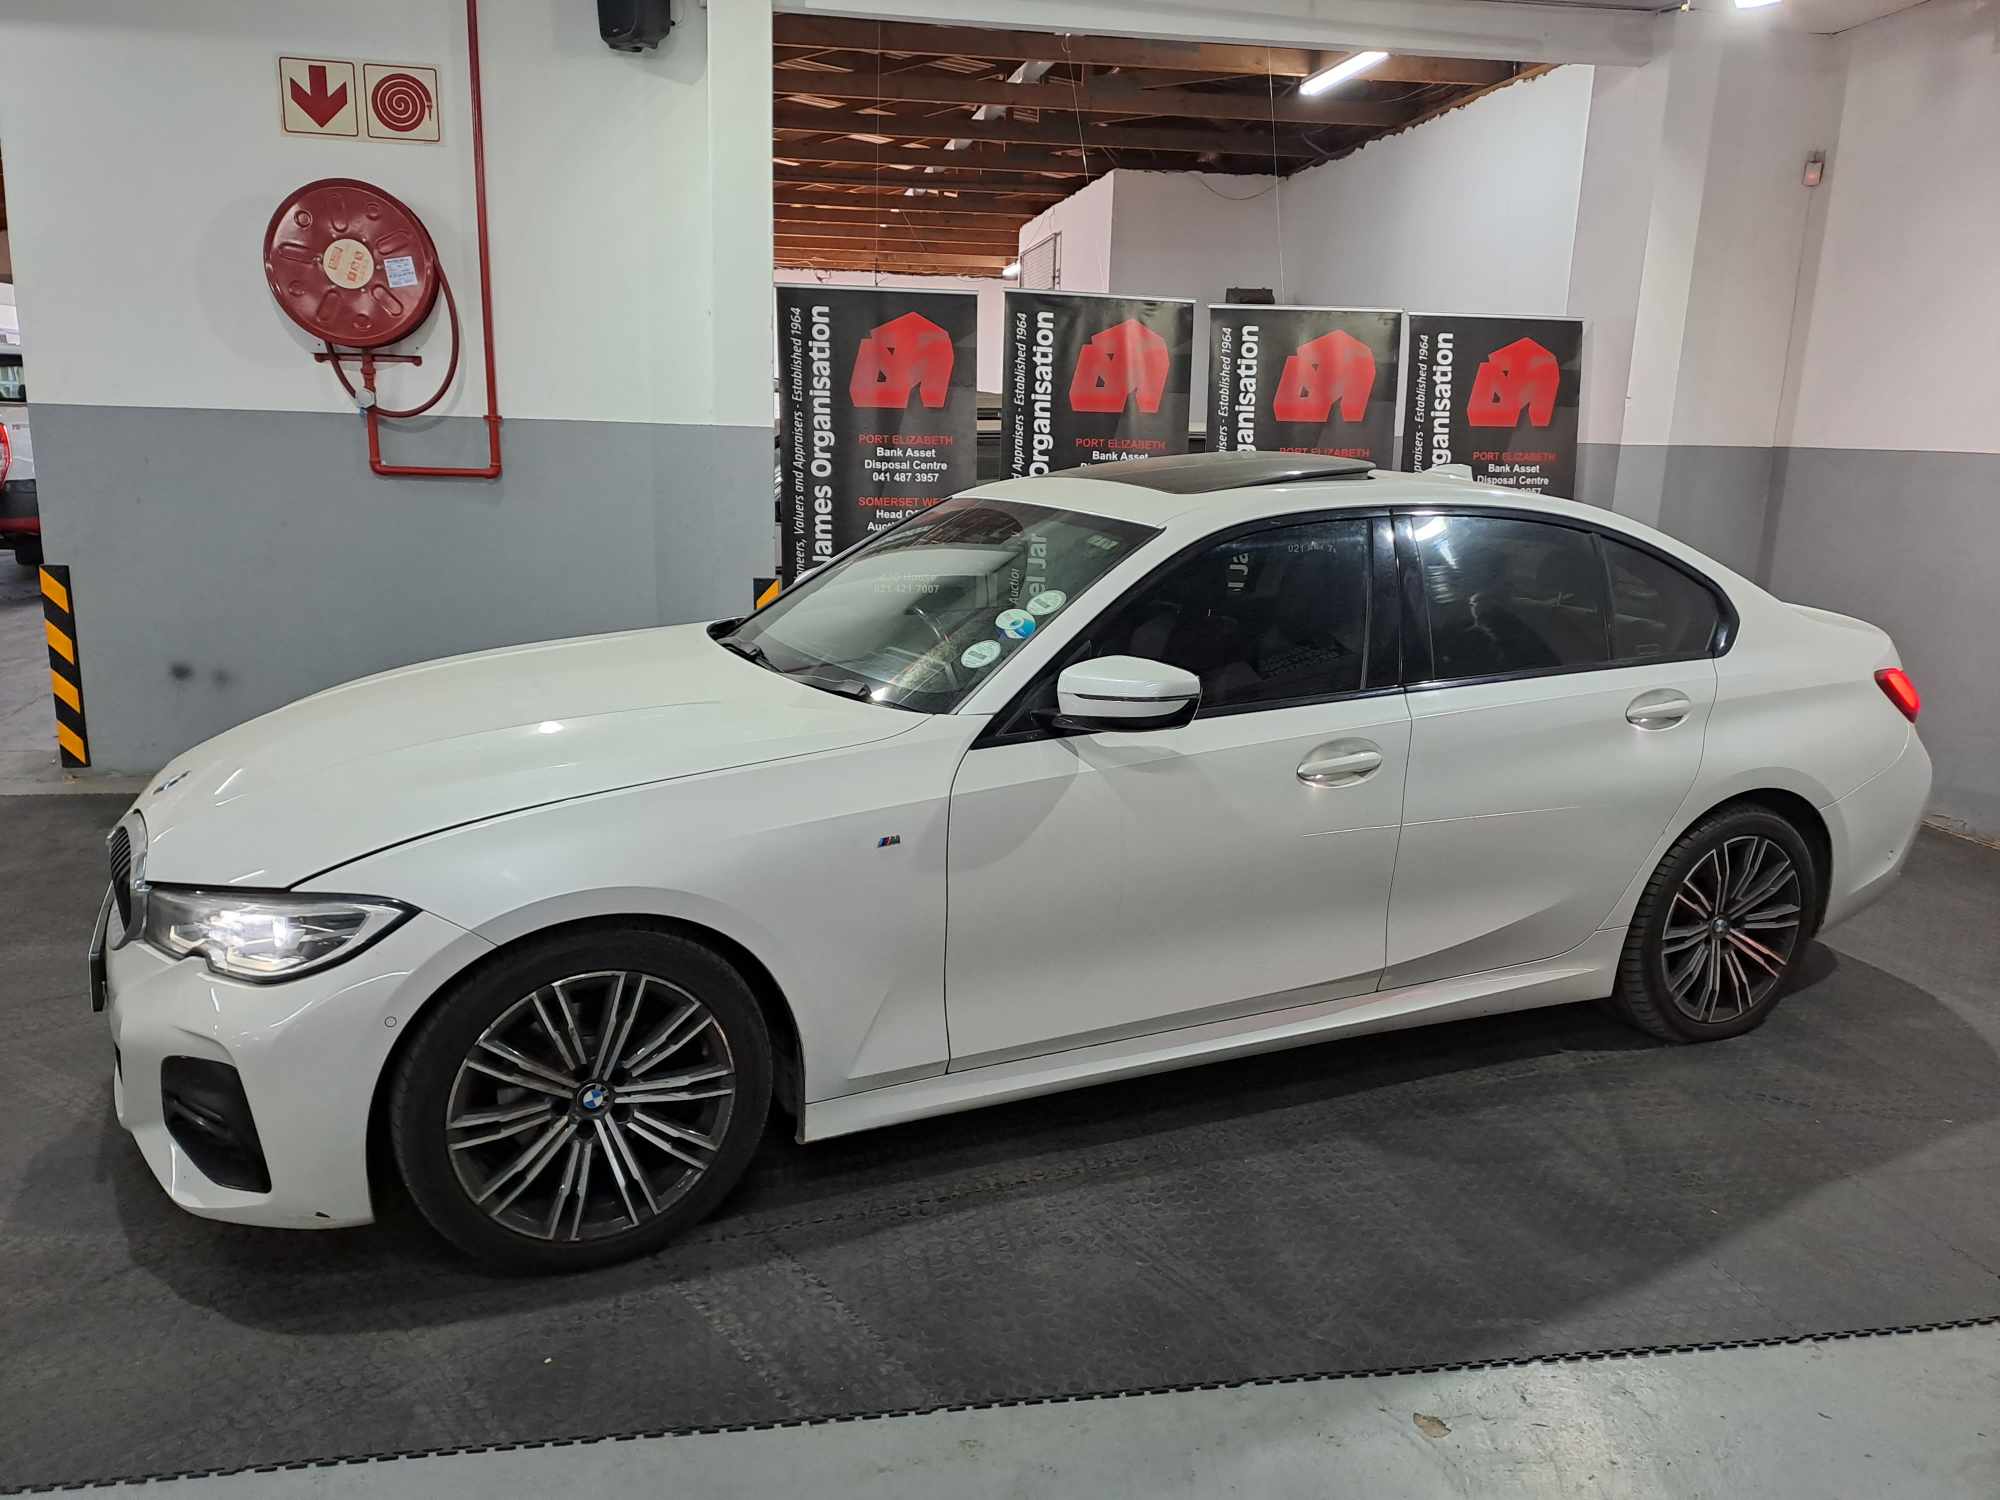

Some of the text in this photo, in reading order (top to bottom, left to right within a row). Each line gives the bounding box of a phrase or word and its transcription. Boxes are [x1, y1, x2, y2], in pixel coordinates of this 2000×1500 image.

[791, 307, 802, 335] 1964
[1016, 313, 1028, 340] 1964
[1221, 327, 1232, 354] 1964
[1418, 334, 1429, 360] 1964
[791, 338, 803, 401] Established
[1014, 343, 1027, 405] Established
[810, 306, 836, 477] Organisation
[1218, 356, 1231, 416] Established
[1415, 363, 1428, 423] Established
[1430, 332, 1454, 465] ganisation
[792, 411, 806, 469] Appraisers
[858, 434, 953, 445] PORT ELIZABETH
[876, 447, 936, 457] Bank Asset
[1011, 414, 1025, 472] Appraisers
[1076, 438, 1165, 449] PORT ELIZABETH
[864, 459, 948, 471] Disposal Centre
[1092, 450, 1118, 460] Bank
[1472, 451, 1500, 461] PORT
[793, 471, 804, 492] and
[872, 472, 939, 482] 041 487 3957
[1477, 475, 1549, 486] Disposal Centre
[1488, 464, 1540, 473] Bank Asset
[858, 496, 919, 506] SOMERSET
[876, 509, 902, 519] Head
[794, 495, 805, 534] Valuers
